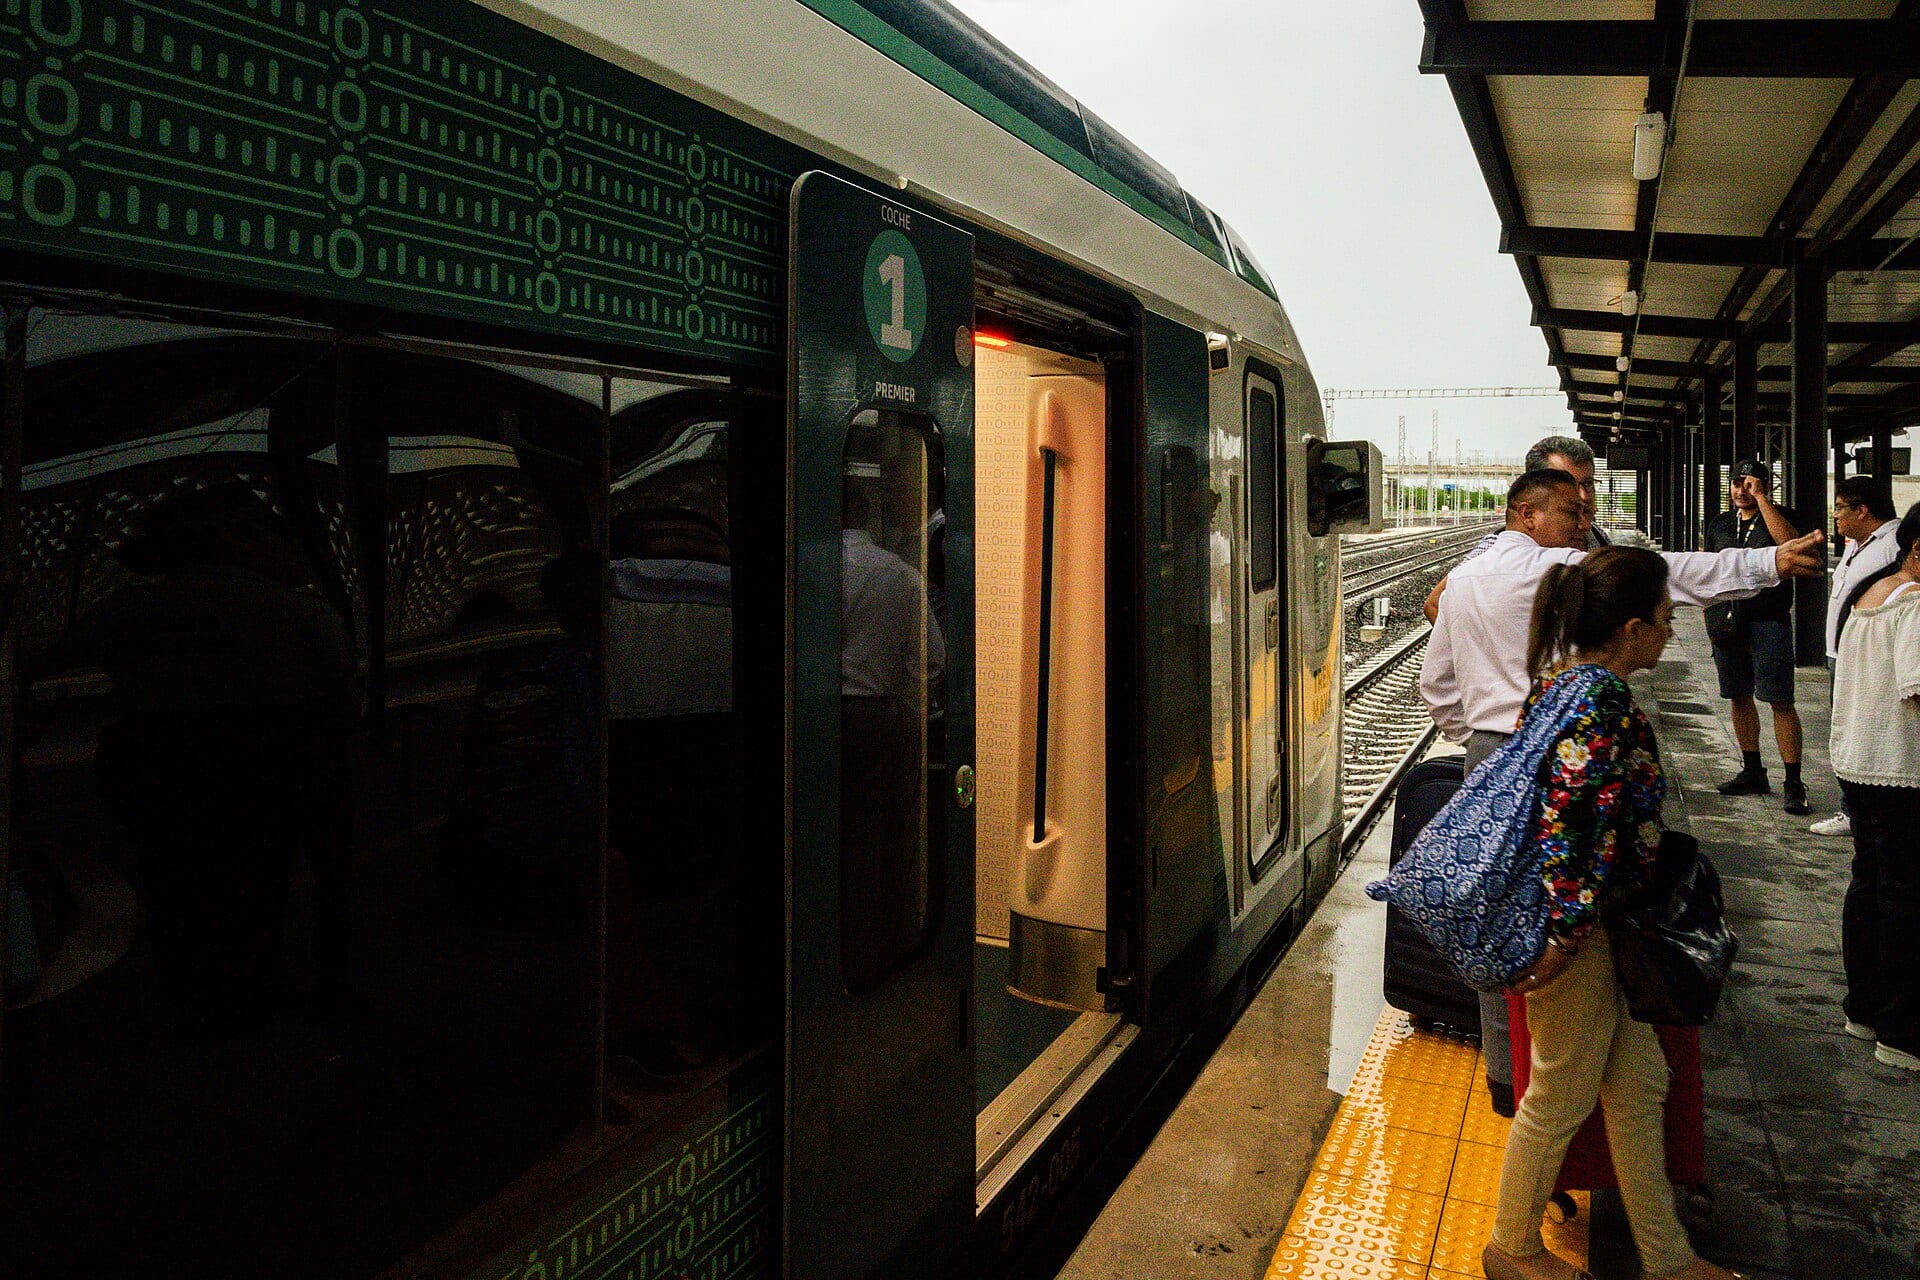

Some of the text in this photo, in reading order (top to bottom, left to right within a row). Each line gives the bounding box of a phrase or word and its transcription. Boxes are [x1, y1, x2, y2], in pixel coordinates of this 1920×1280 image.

[881, 204, 912, 231] COCHE
[878, 254, 912, 351] 1
[875, 381, 915, 402] PREMIER
